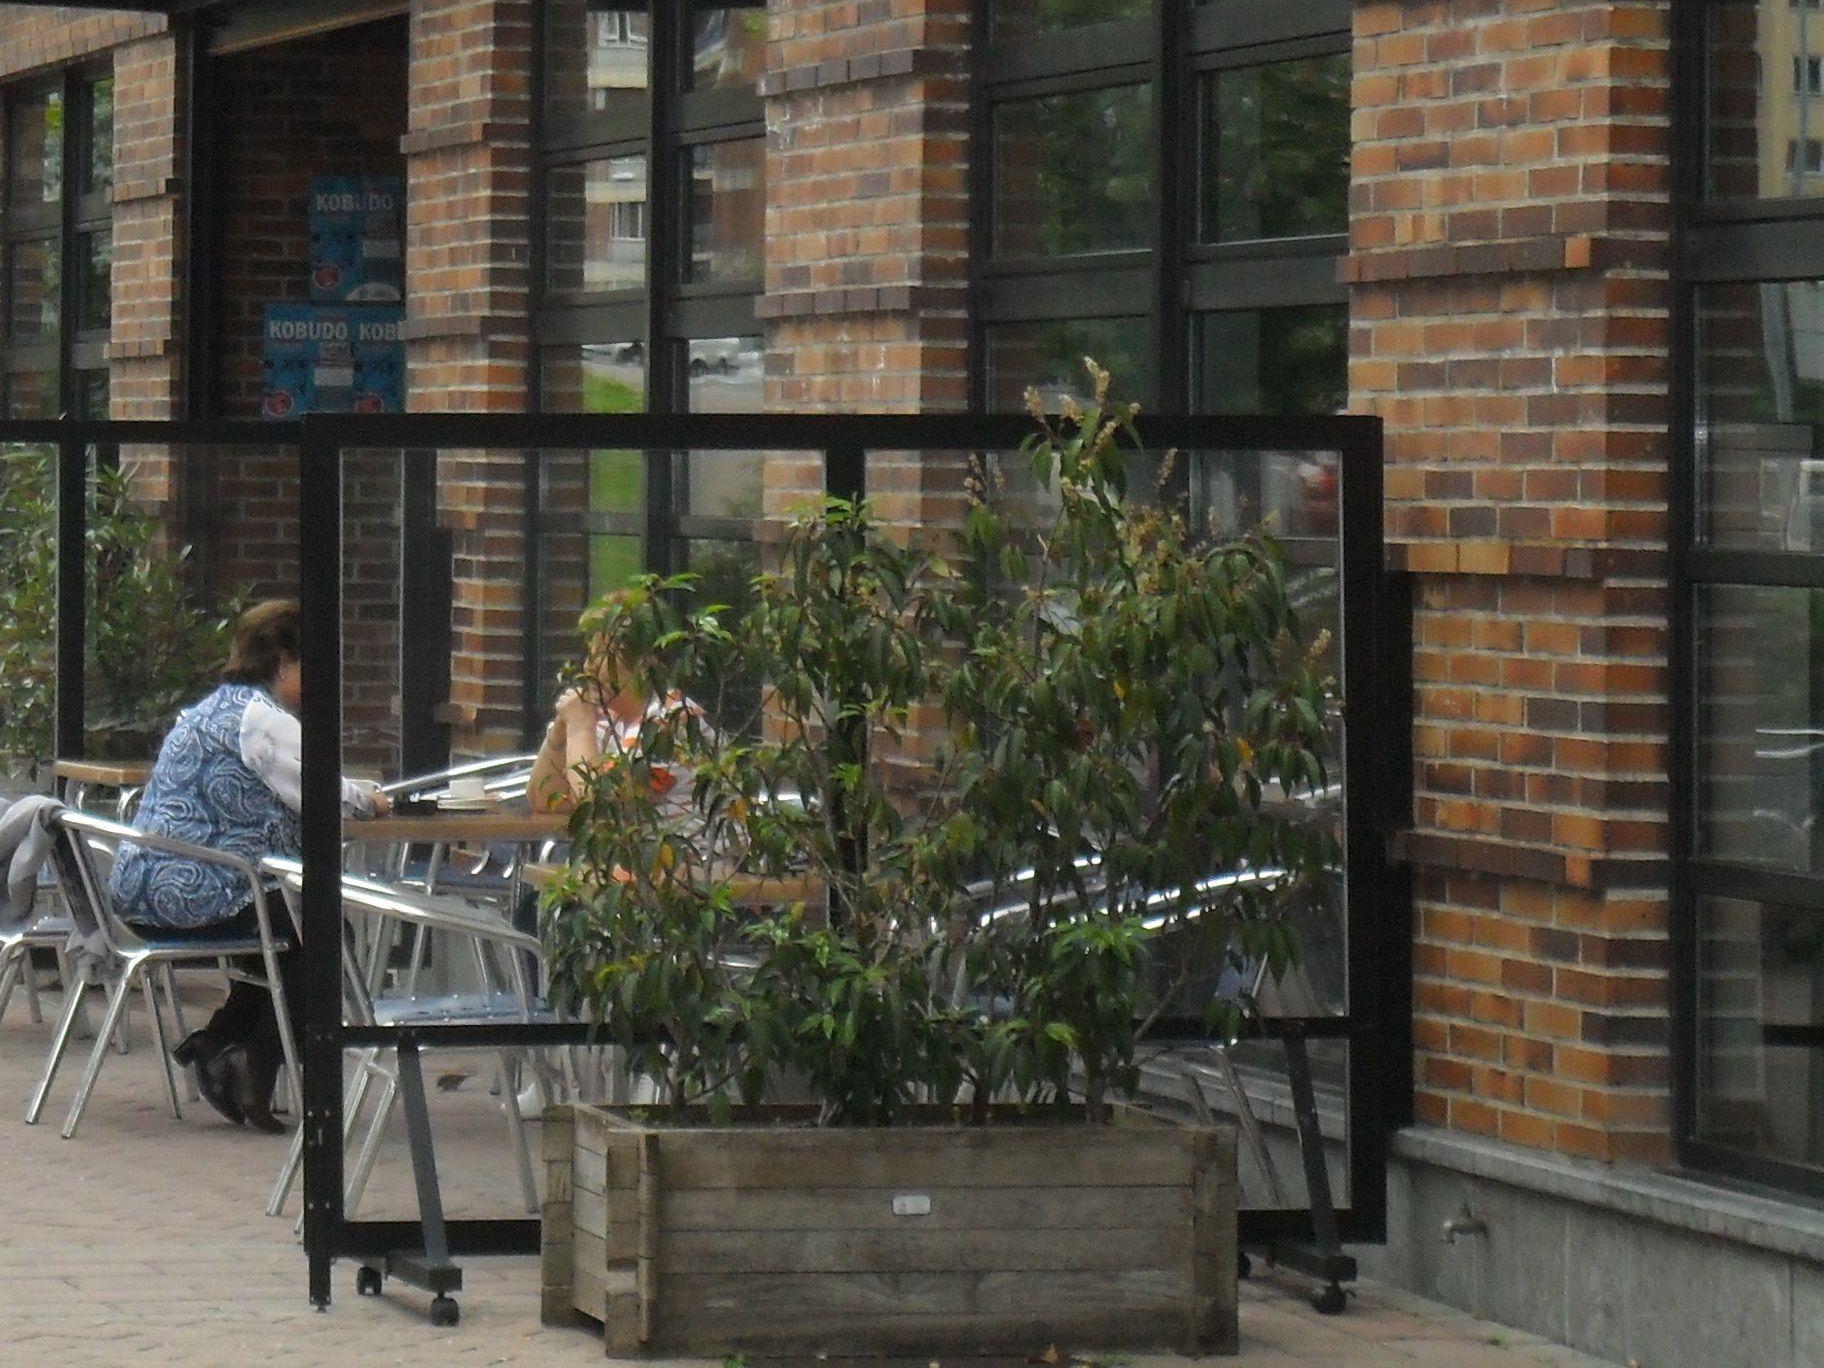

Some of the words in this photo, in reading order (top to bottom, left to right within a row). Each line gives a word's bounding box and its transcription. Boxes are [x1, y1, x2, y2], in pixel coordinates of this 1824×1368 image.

[316, 193, 395, 212] KOBUDO
[269, 320, 348, 341] KOBUDO
[358, 322, 400, 341] KOB
